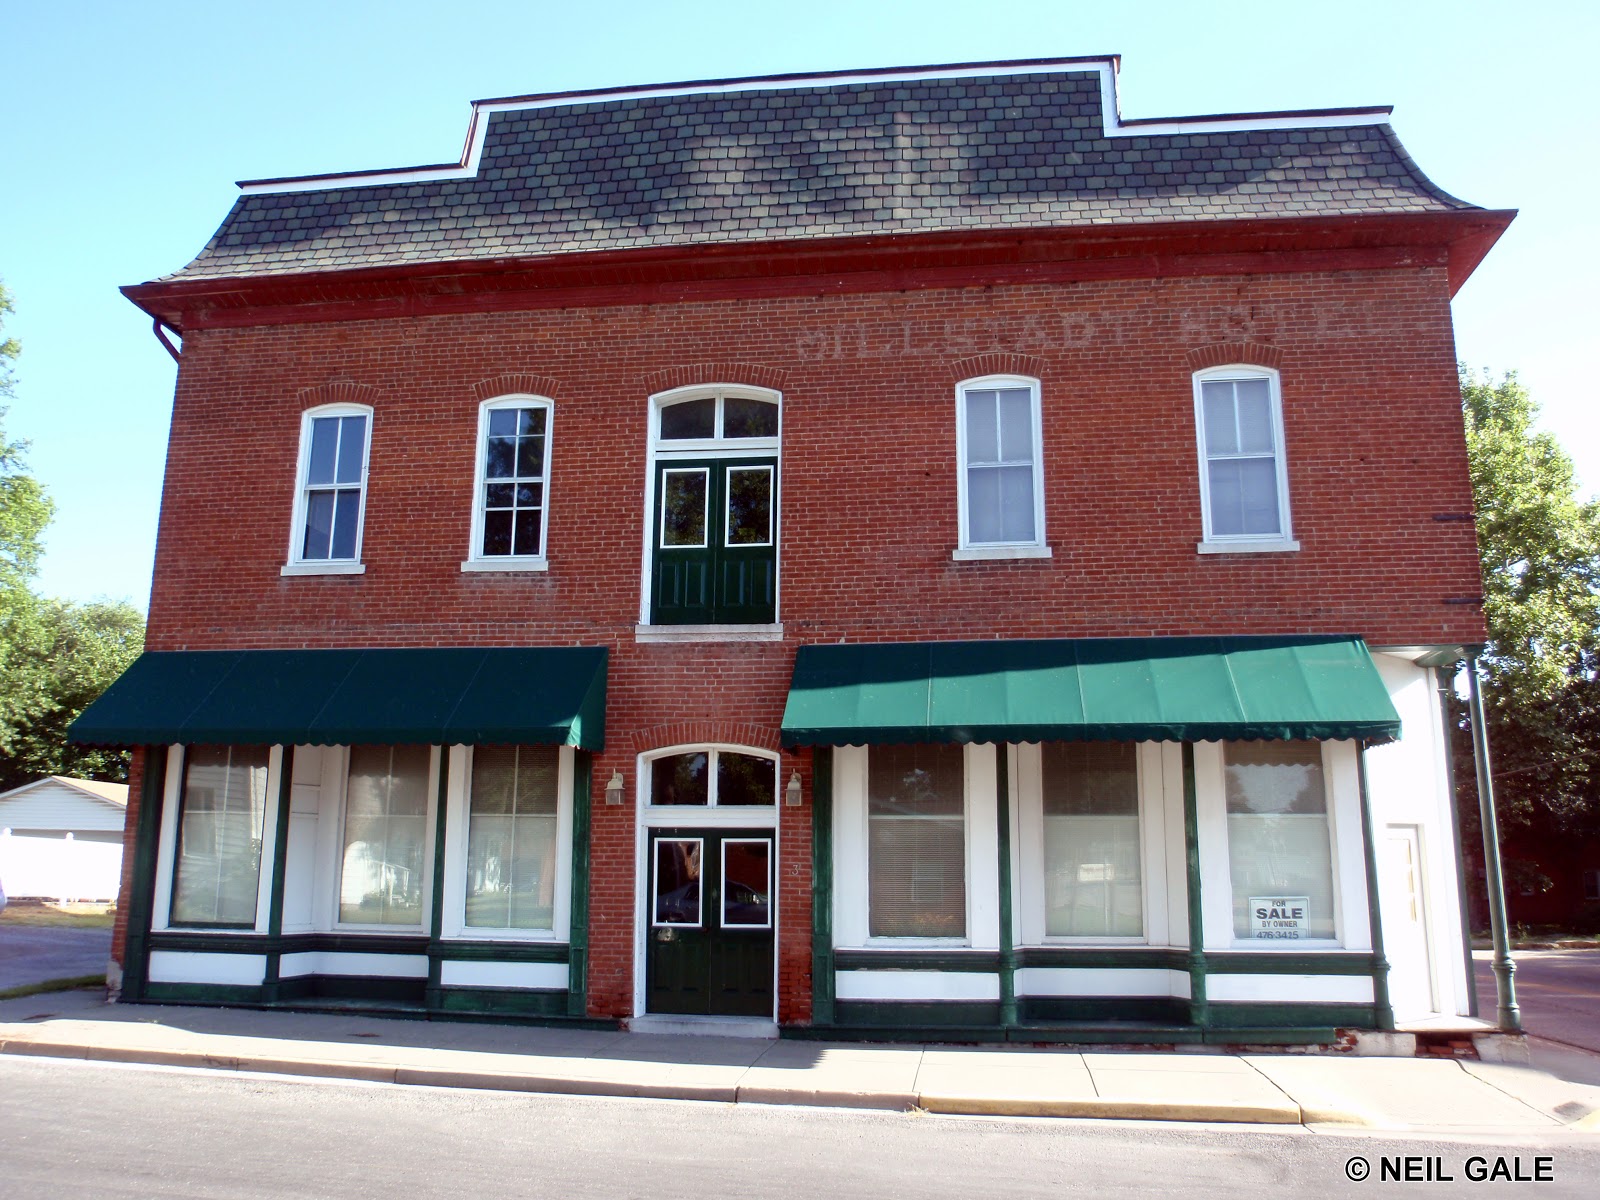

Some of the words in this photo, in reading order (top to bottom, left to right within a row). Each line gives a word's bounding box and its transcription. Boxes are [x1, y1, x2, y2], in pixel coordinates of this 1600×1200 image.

[791, 864, 799, 876] 3
[1256, 908, 1303, 920] SALE
[1262, 920, 1271, 928] BY
[1273, 920, 1298, 928] OWNER
